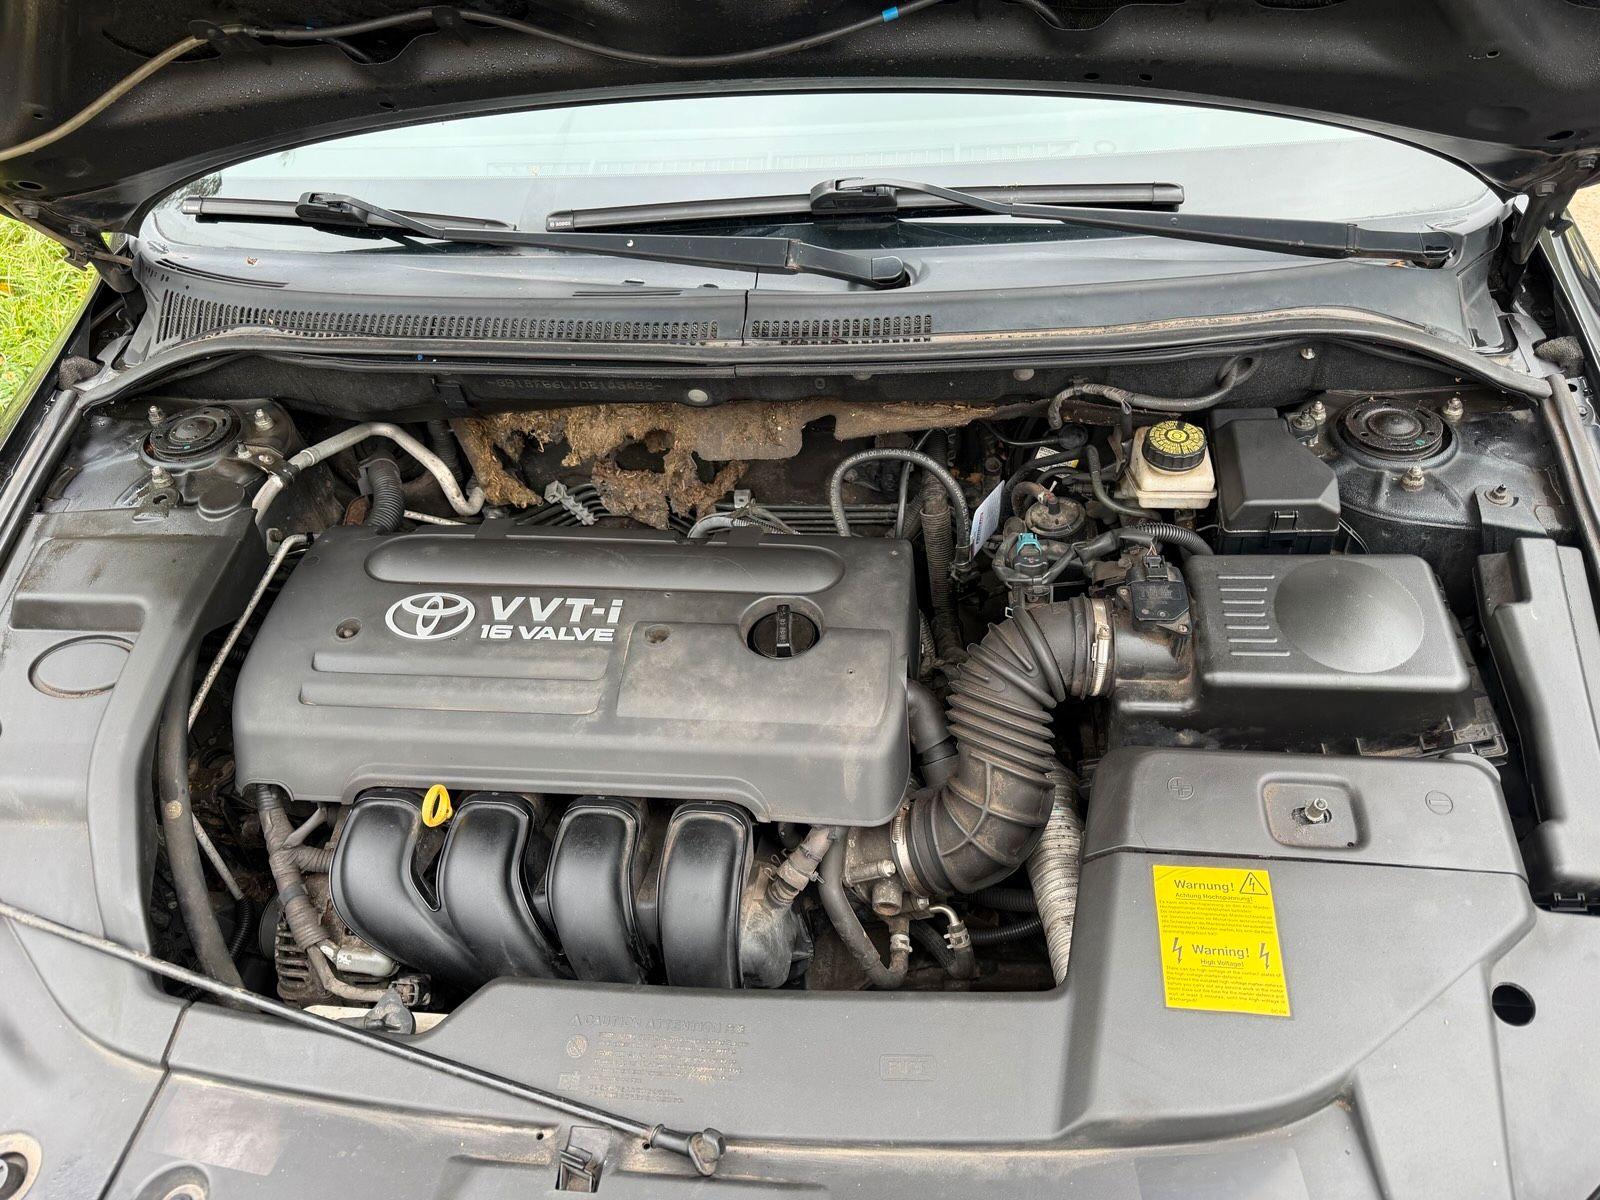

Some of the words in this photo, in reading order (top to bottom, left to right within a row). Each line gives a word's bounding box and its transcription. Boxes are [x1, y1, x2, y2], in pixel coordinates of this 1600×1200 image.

[491, 596, 623, 623] VVT-i
[480, 625, 514, 639] 16
[519, 626, 615, 641] VALVE
[1174, 879, 1235, 893] Warnung!
[1175, 892, 1201, 900] Achtung
[1192, 944, 1249, 959] Warning!
[1200, 958, 1216, 966] High
[1218, 960, 1244, 968] Voltage!
